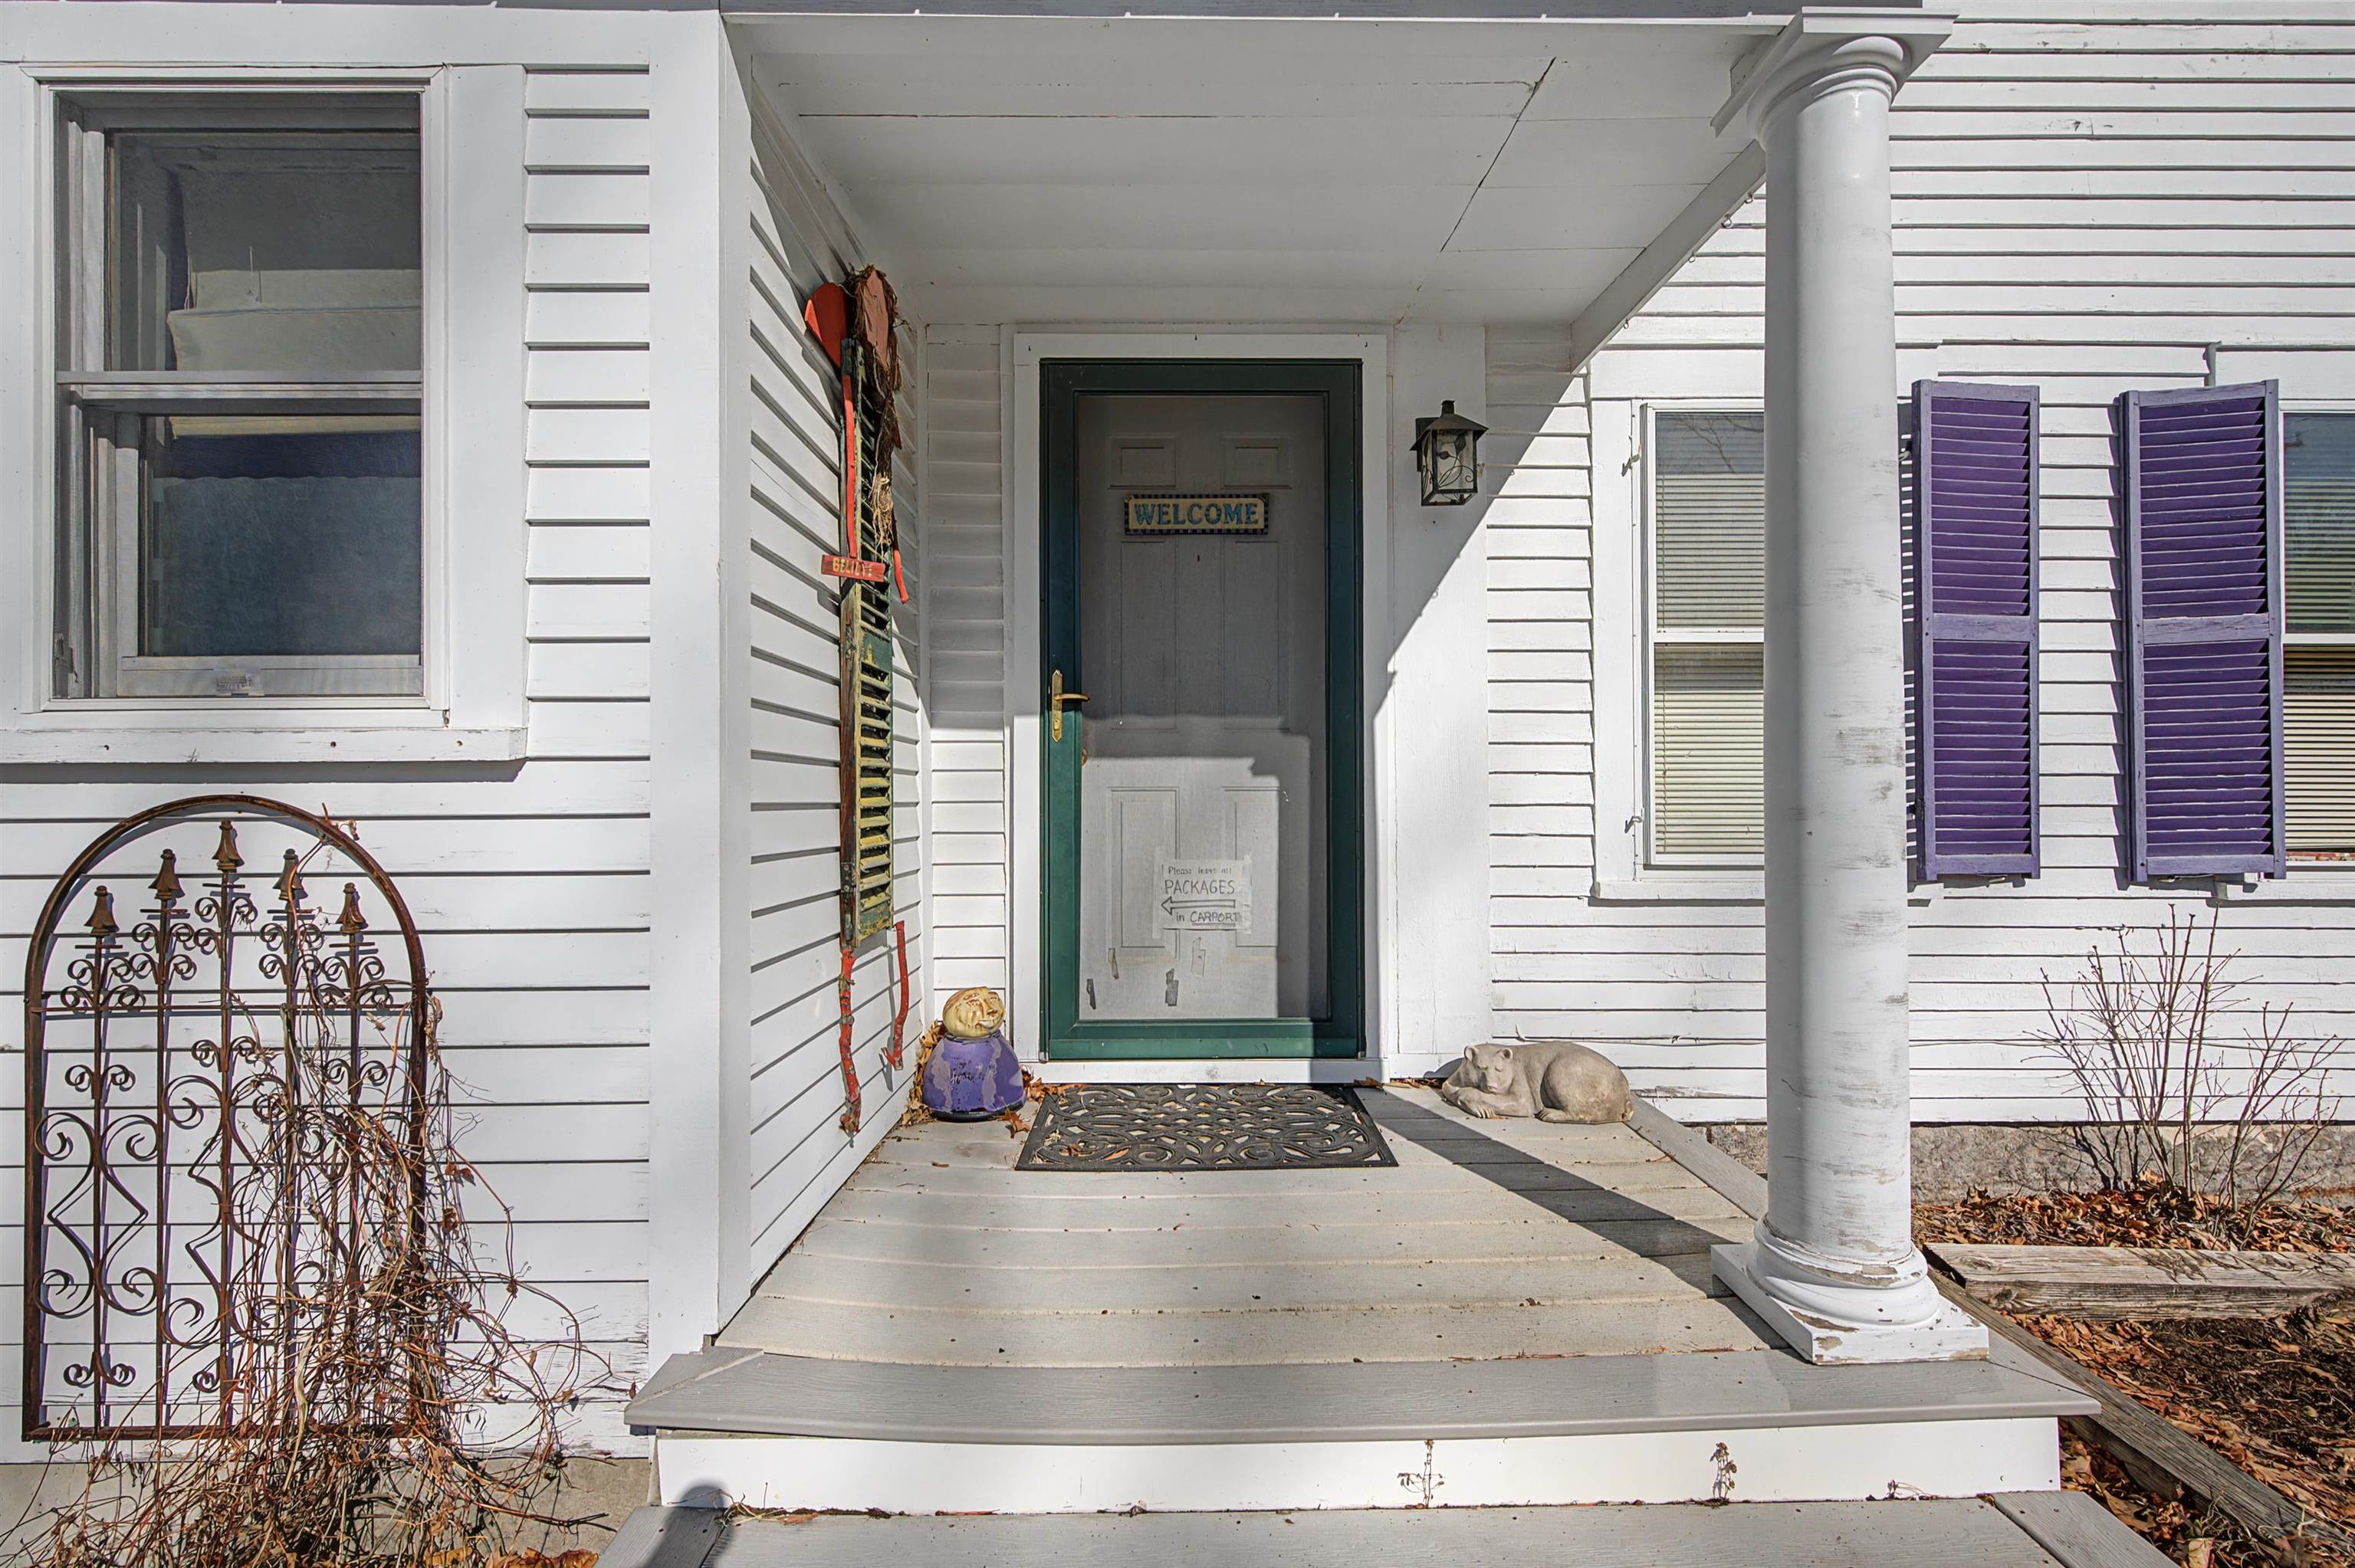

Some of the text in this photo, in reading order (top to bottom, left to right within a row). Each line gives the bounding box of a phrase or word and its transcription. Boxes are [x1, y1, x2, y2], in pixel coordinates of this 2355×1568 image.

[1134, 503, 1259, 525] WELCOME
[1168, 866, 1191, 874] Please
[1164, 879, 1235, 894] PACKAGES
[1176, 910, 1240, 923] in CARPORT
